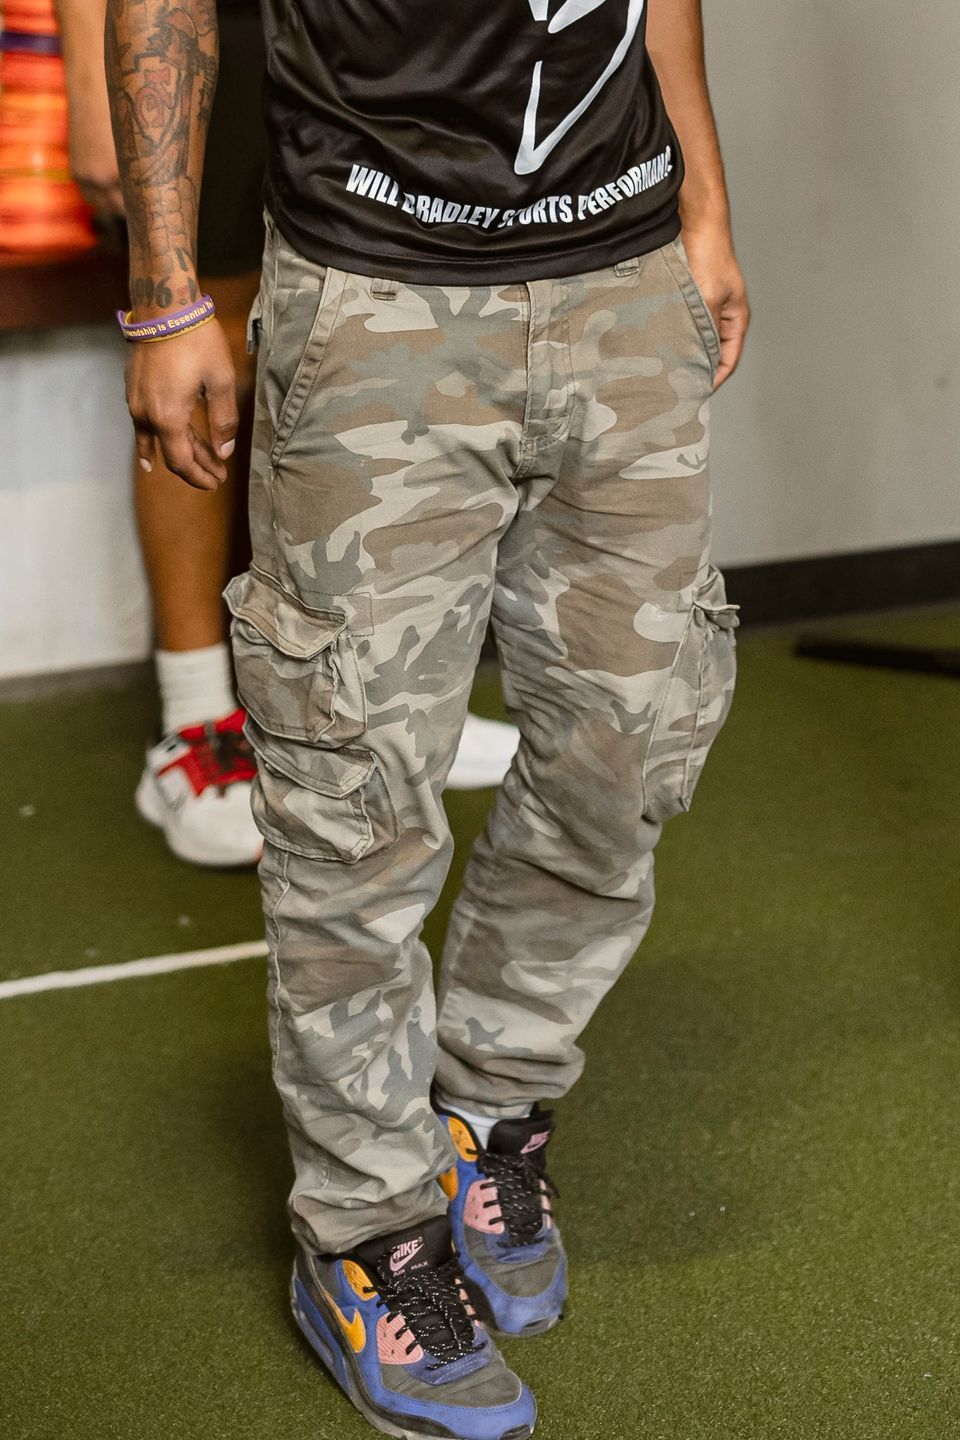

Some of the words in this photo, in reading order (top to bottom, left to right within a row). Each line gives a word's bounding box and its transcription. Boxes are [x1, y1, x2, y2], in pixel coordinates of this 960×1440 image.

[346, 164, 399, 207] WILL
[401, 191, 500, 229] BRADLEY
[168, 305, 206, 327] Essential
